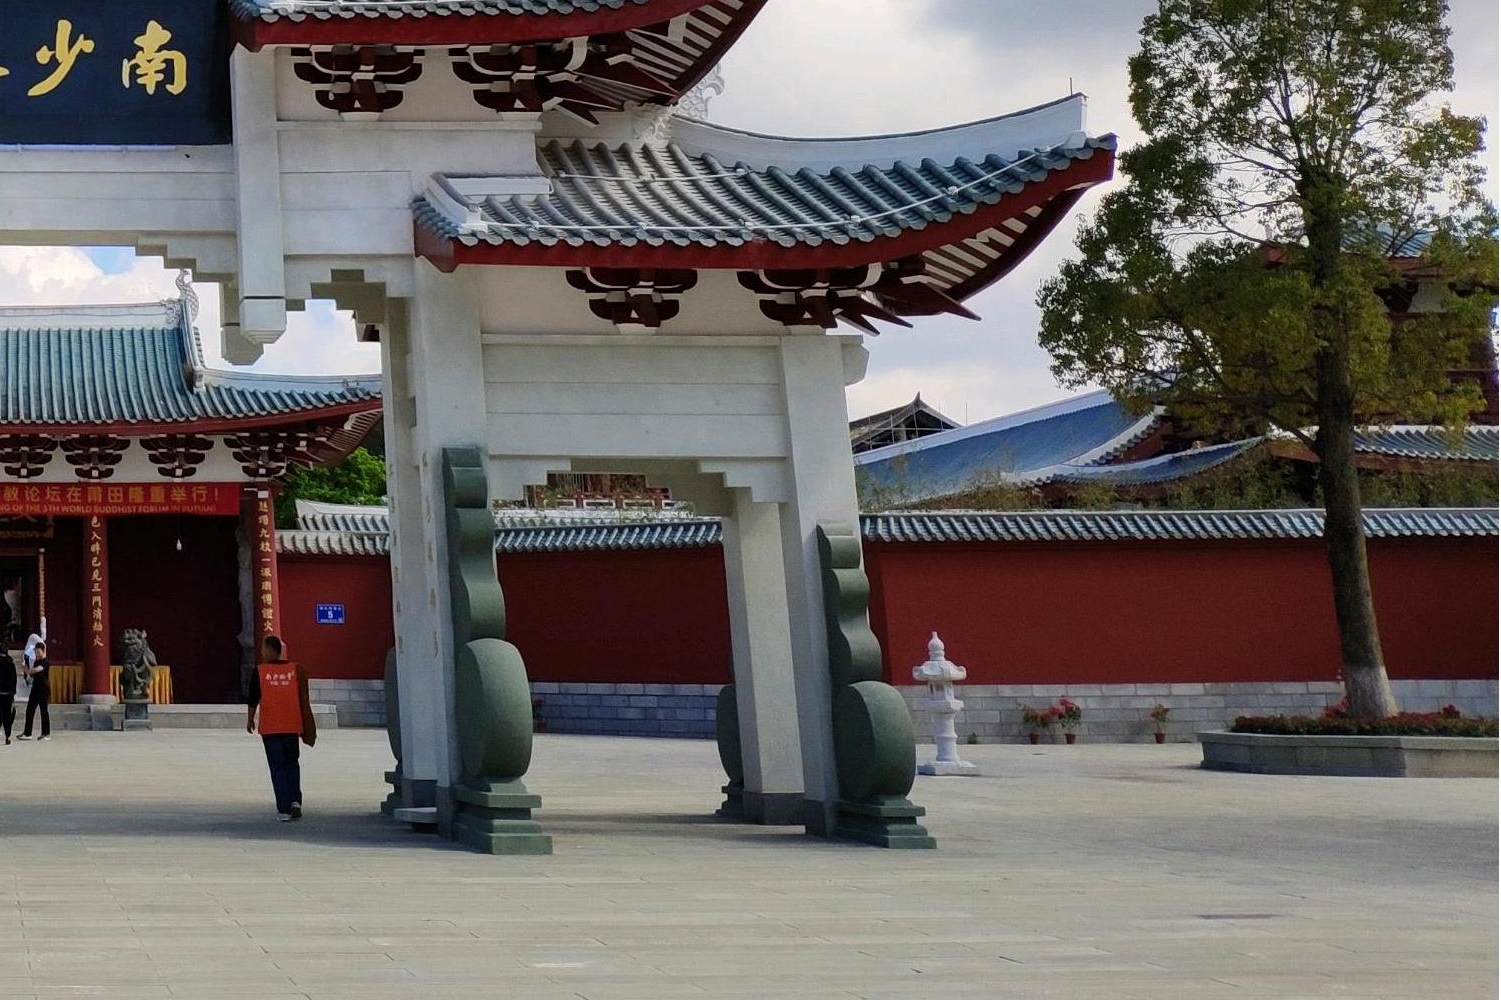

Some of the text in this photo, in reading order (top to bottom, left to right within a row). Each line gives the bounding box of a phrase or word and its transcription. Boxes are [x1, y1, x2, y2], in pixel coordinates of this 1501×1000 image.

[12, 503, 23, 514] OF
[25, 503, 41, 514] THE
[62, 503, 92, 514] WORLD
[93, 503, 136, 514] BUDDHIST
[137, 503, 169, 514] FORUM
[327, 610, 334, 619] 5
